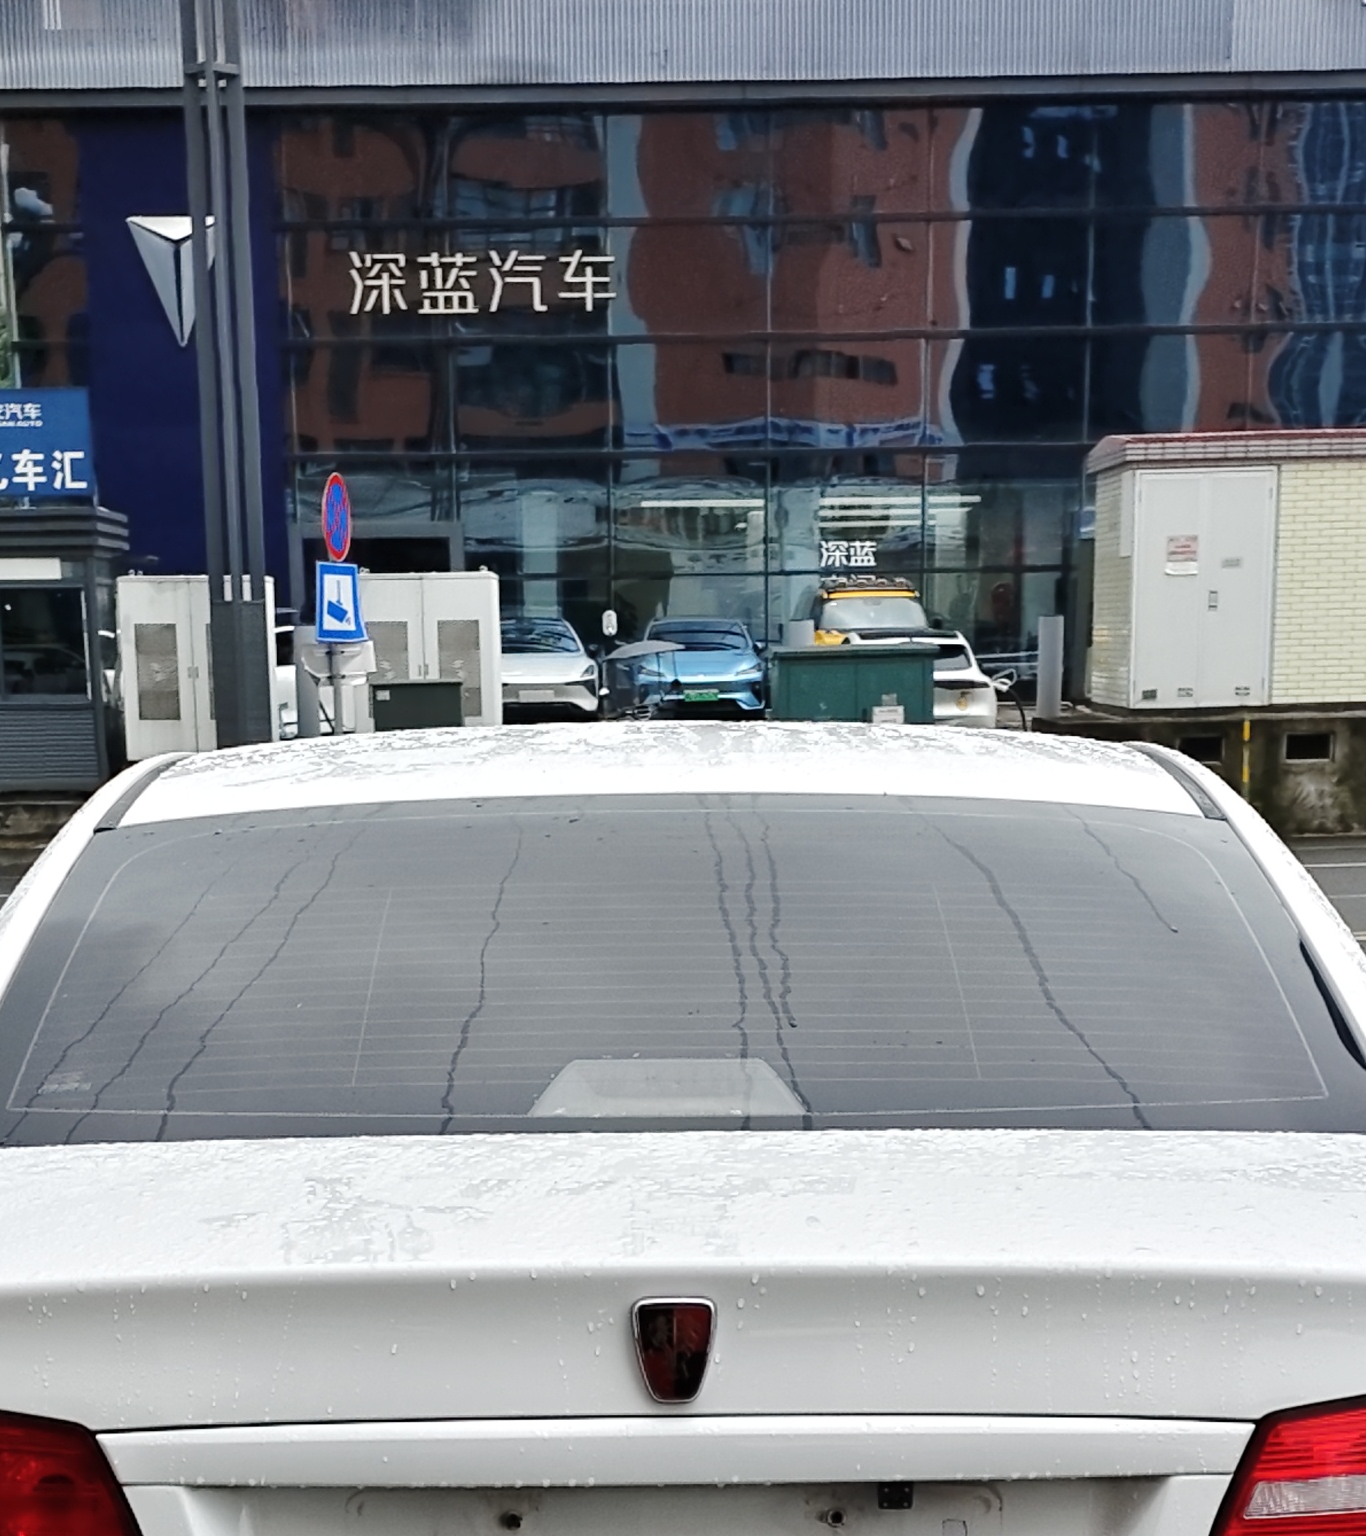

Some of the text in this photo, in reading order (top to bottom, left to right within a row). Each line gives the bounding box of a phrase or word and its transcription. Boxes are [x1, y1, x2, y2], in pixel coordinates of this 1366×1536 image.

[349, 249, 617, 315] 深蓝汽车
[819, 540, 877, 568] 深蓝
